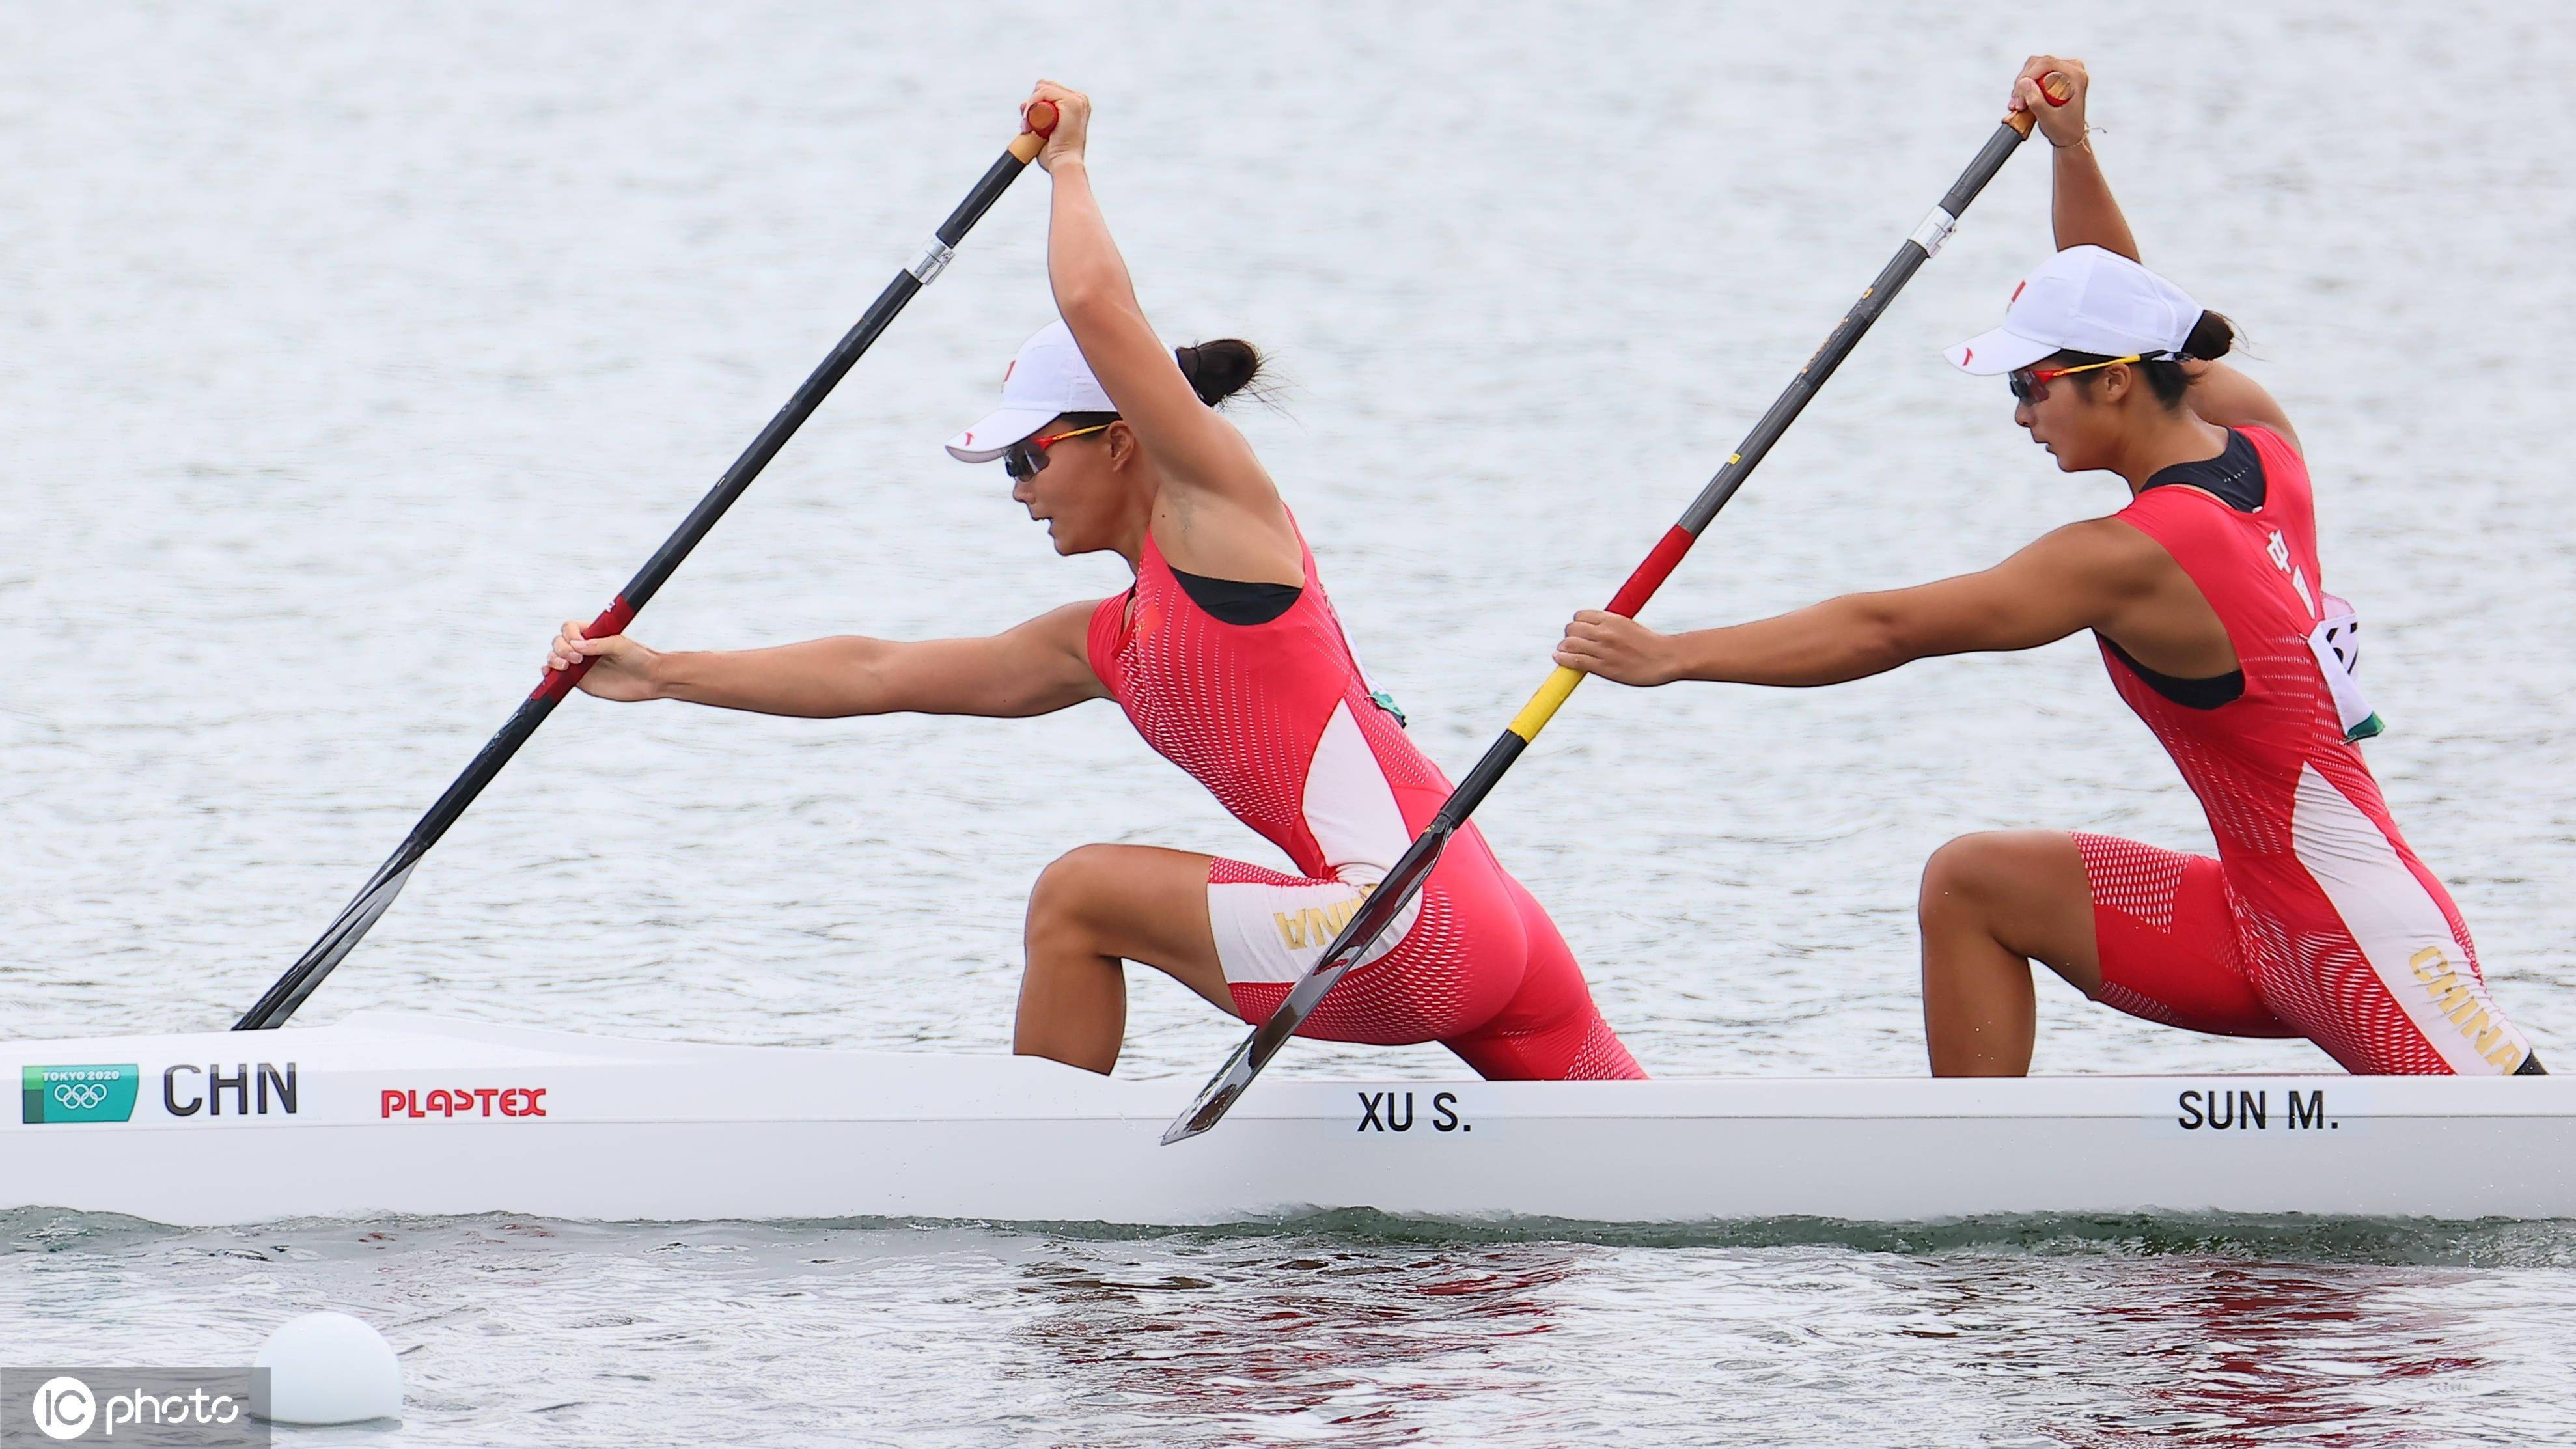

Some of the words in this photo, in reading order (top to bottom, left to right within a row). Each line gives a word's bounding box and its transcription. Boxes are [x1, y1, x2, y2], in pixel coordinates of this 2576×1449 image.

[42, 1071, 86, 1081] TOKYO
[87, 1070, 120, 1081] 2020
[163, 1062, 296, 1117] CHN
[381, 1088, 546, 1118] PLASTEX
[1357, 1092, 1413, 1132] XU
[1433, 1092, 1471, 1132] S.
[2178, 1090, 2266, 1130] SUN
[2288, 1090, 2339, 1129] M.
